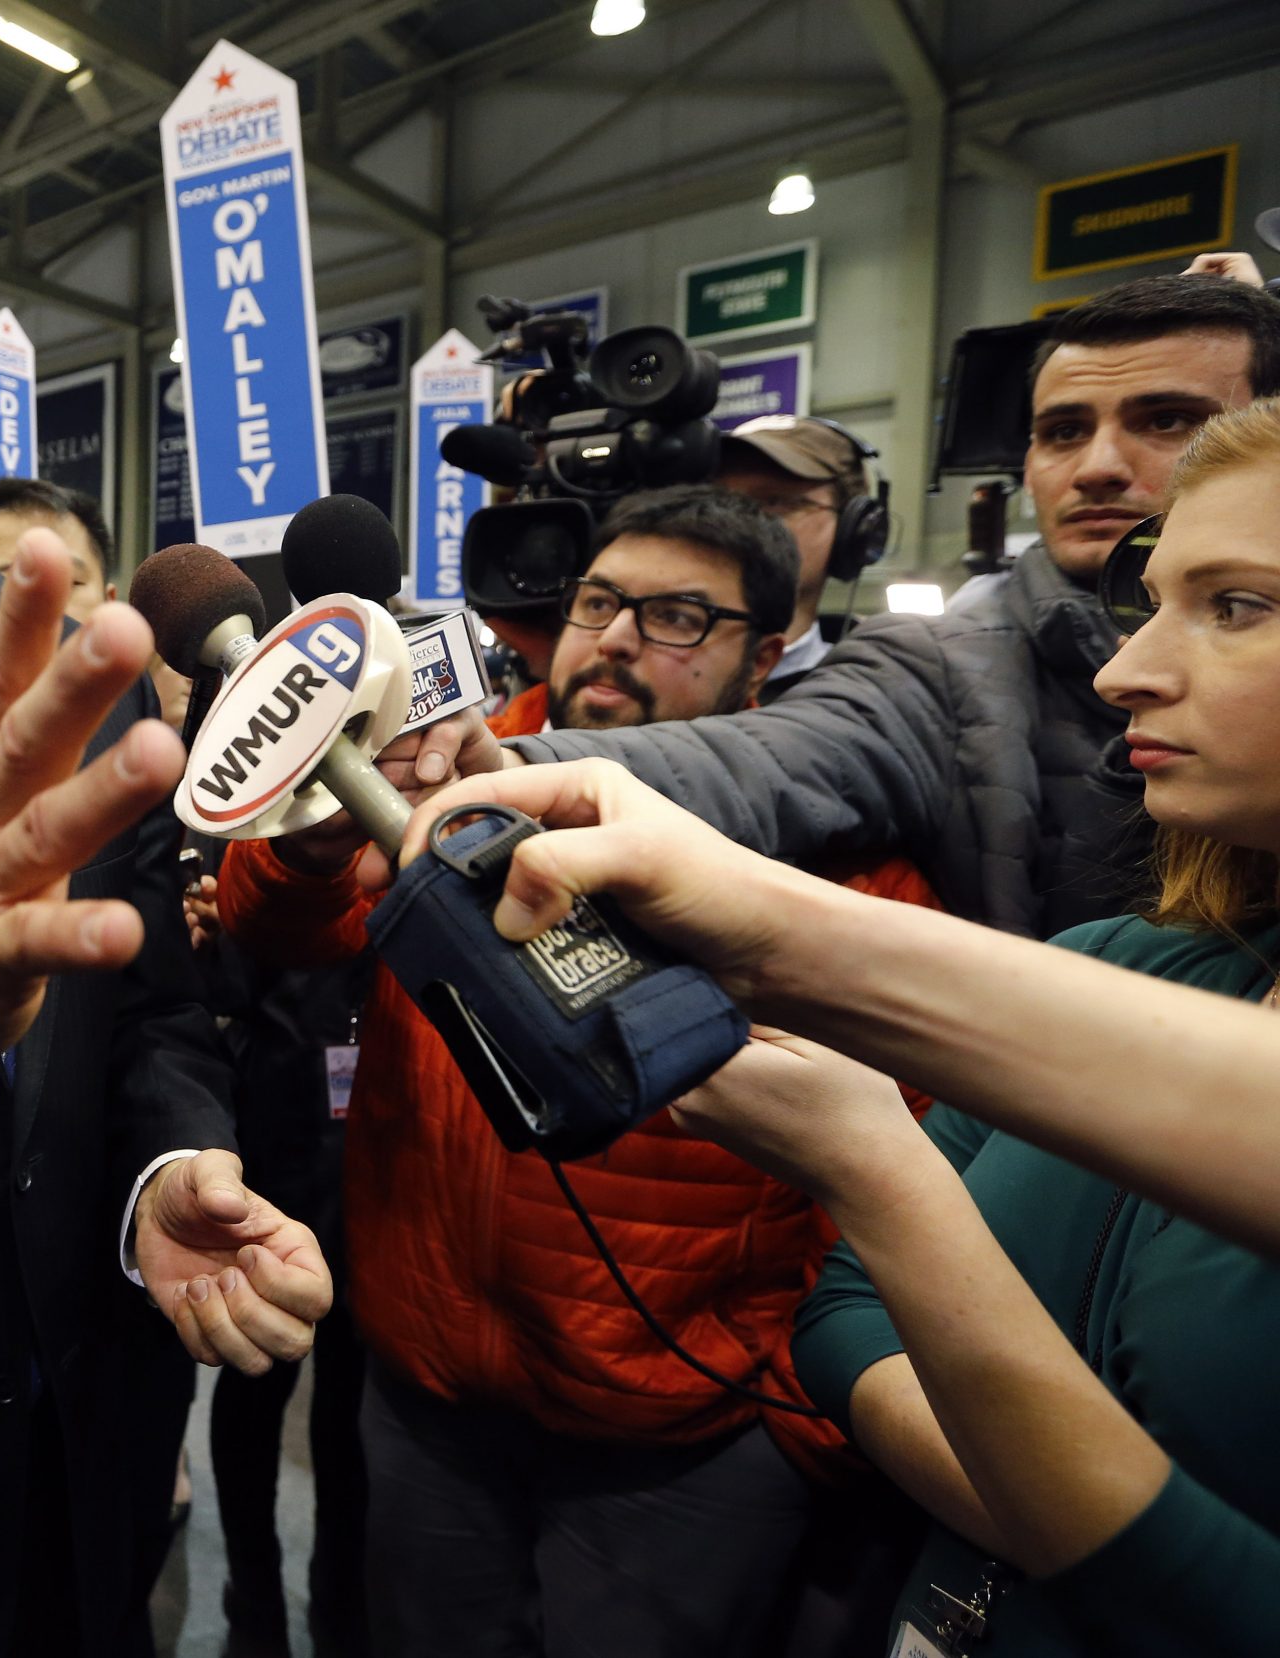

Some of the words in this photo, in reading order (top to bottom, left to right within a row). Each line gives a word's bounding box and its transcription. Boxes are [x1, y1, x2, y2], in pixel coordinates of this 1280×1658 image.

[178, 112, 282, 160] DEBATE
[178, 183, 220, 208] GOV.
[222, 165, 292, 198] MARTIN
[213, 193, 276, 506] O'MALLEY
[432, 405, 472, 420] JULIA
[410, 643, 440, 661] ierce
[412, 667, 436, 698] ald
[196, 663, 329, 802] WMUR
[306, 621, 361, 674] 9
[408, 689, 441, 722] 2016
[556, 937, 620, 986] brace
